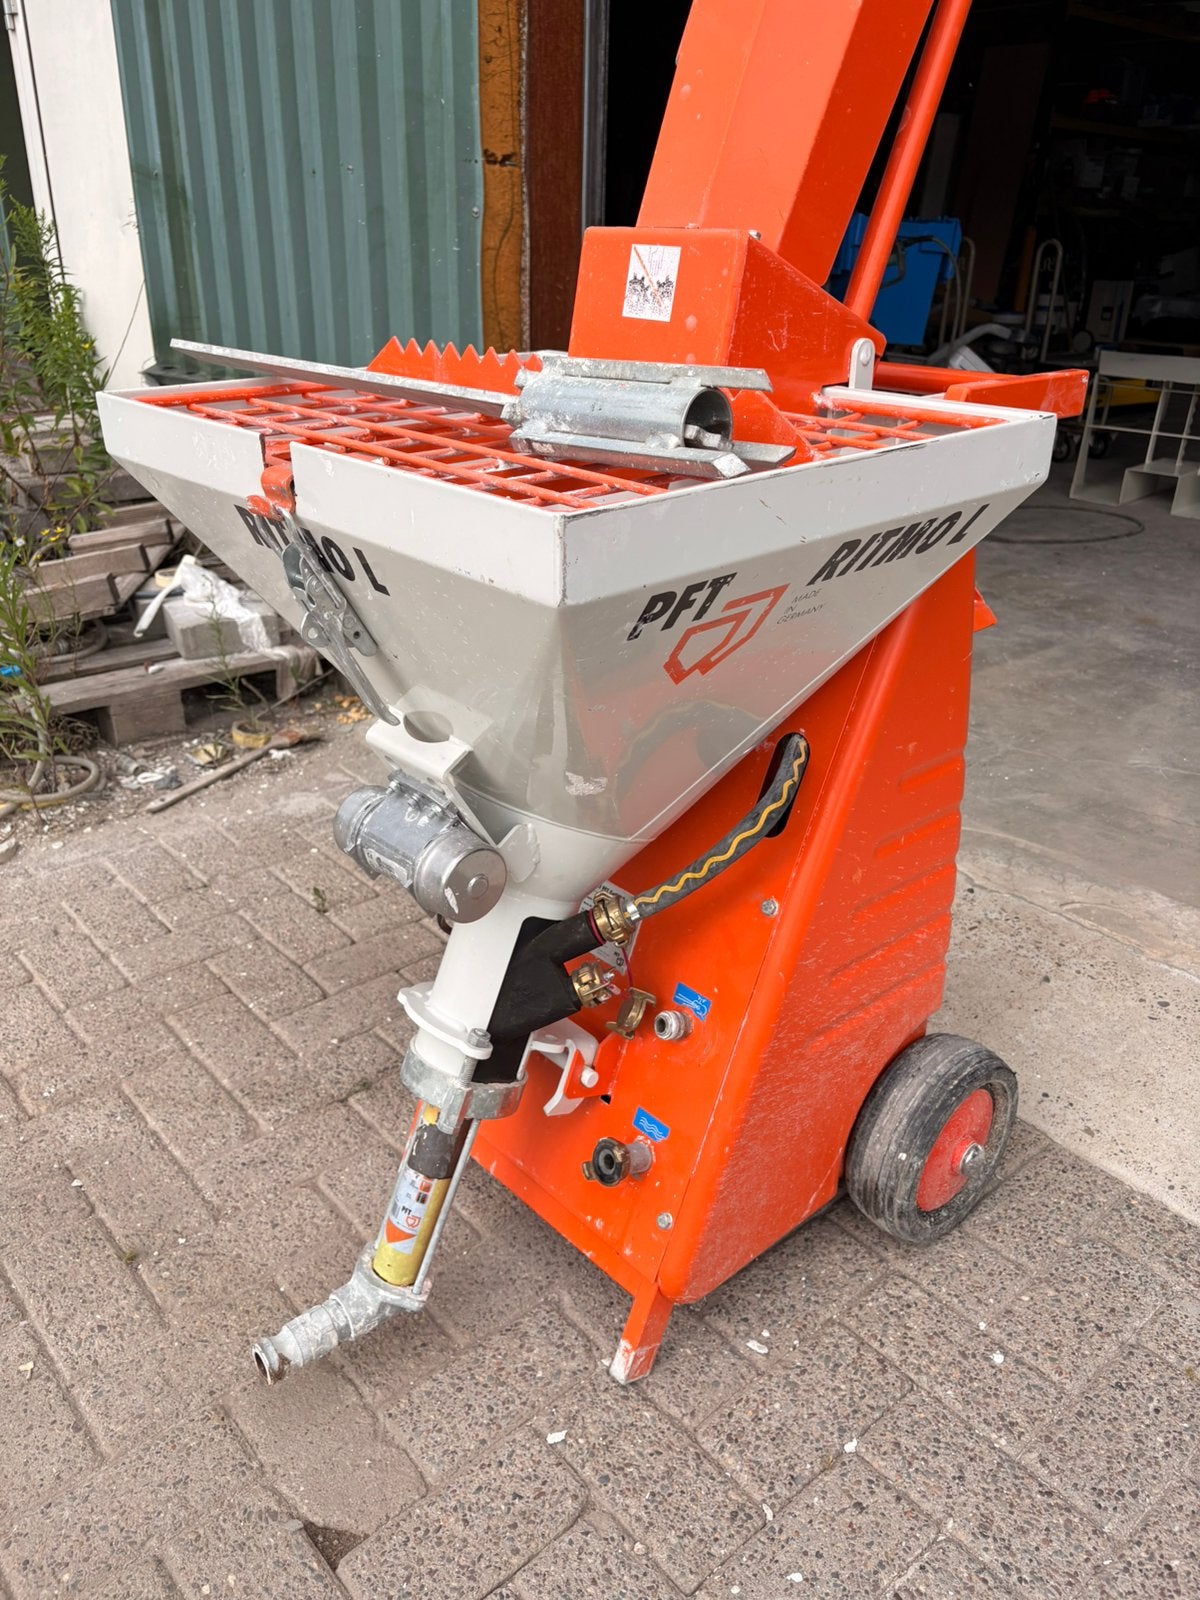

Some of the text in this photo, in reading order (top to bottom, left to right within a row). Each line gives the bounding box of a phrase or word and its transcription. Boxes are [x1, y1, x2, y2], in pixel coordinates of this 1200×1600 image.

[807, 503, 991, 586] RITMO L
[352, 546, 391, 597] L
[626, 572, 738, 642] PFT
[776, 602, 828, 625] GERMANY
[784, 603, 798, 615] IN
[791, 588, 823, 604] MADE
